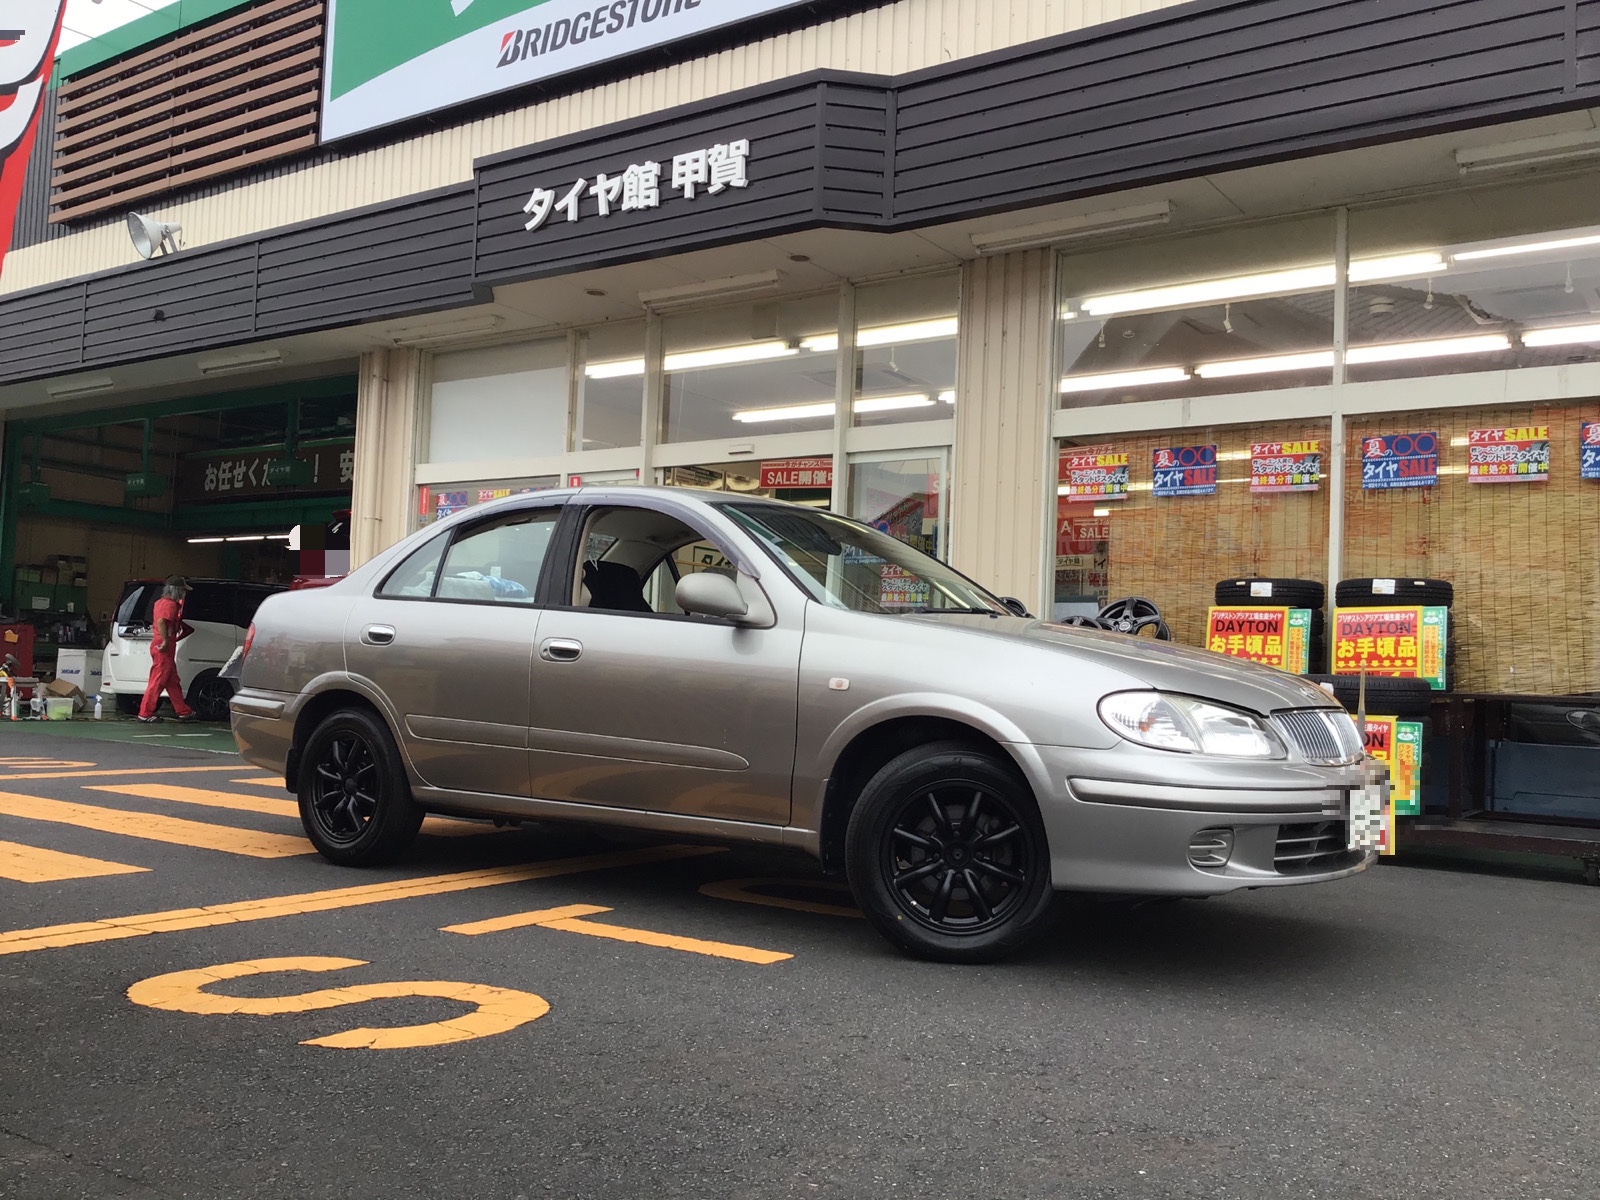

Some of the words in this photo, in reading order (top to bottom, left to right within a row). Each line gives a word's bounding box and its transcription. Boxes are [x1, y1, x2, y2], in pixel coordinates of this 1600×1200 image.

[523, 160, 661, 232] タイヤ館
[671, 138, 750, 200] 甲賀
[1582, 449, 1600, 467] タ
[1469, 462, 1548, 475] 最終処分市開催中
[1215, 620, 1279, 633] DAYTON
[1341, 622, 1412, 636] DAYTON
[1210, 634, 1282, 656] お手頃品
[1337, 636, 1417, 658] お手頃品
